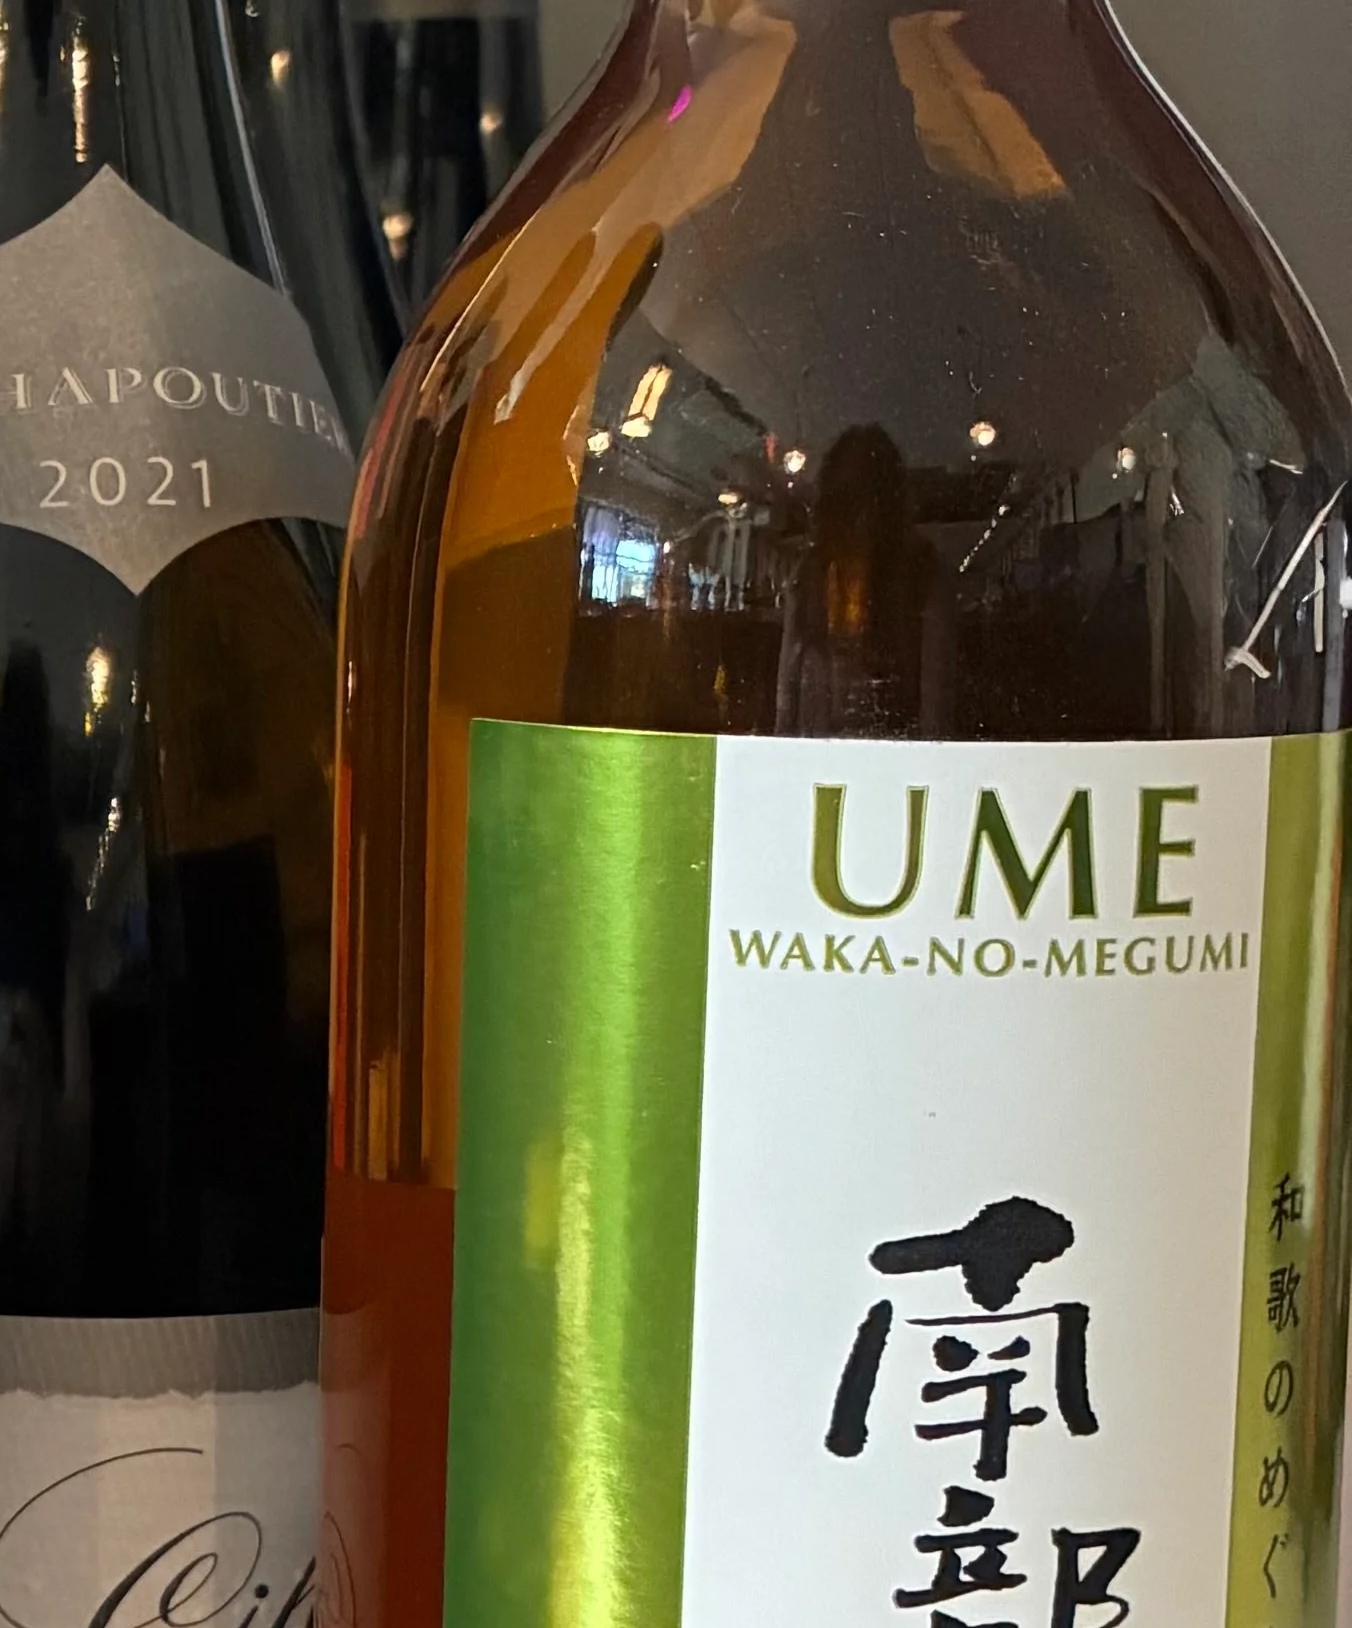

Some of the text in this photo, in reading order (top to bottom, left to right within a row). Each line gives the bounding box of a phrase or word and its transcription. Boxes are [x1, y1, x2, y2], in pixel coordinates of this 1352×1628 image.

[39, 457, 211, 507] 2021
[812, 784, 1199, 920] UME
[729, 929, 1250, 978] WAKA-NO-MEGUMI
